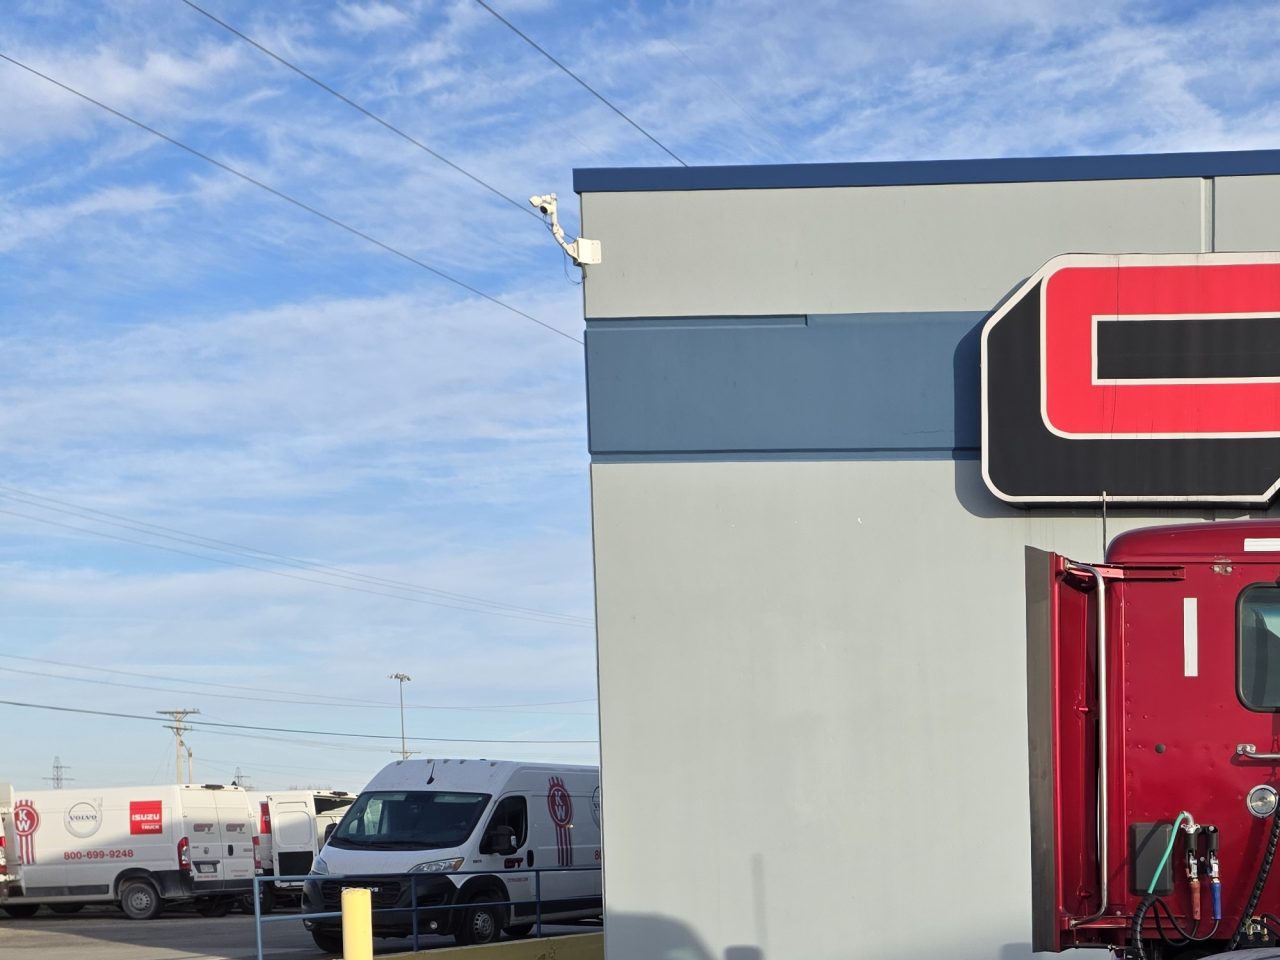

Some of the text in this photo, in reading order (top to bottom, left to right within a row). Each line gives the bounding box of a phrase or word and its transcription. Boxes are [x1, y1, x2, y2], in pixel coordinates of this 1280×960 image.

[68, 814, 98, 822] VOLVO
[132, 813, 160, 821] ISUZU
[63, 848, 134, 861] 800-699-9248
